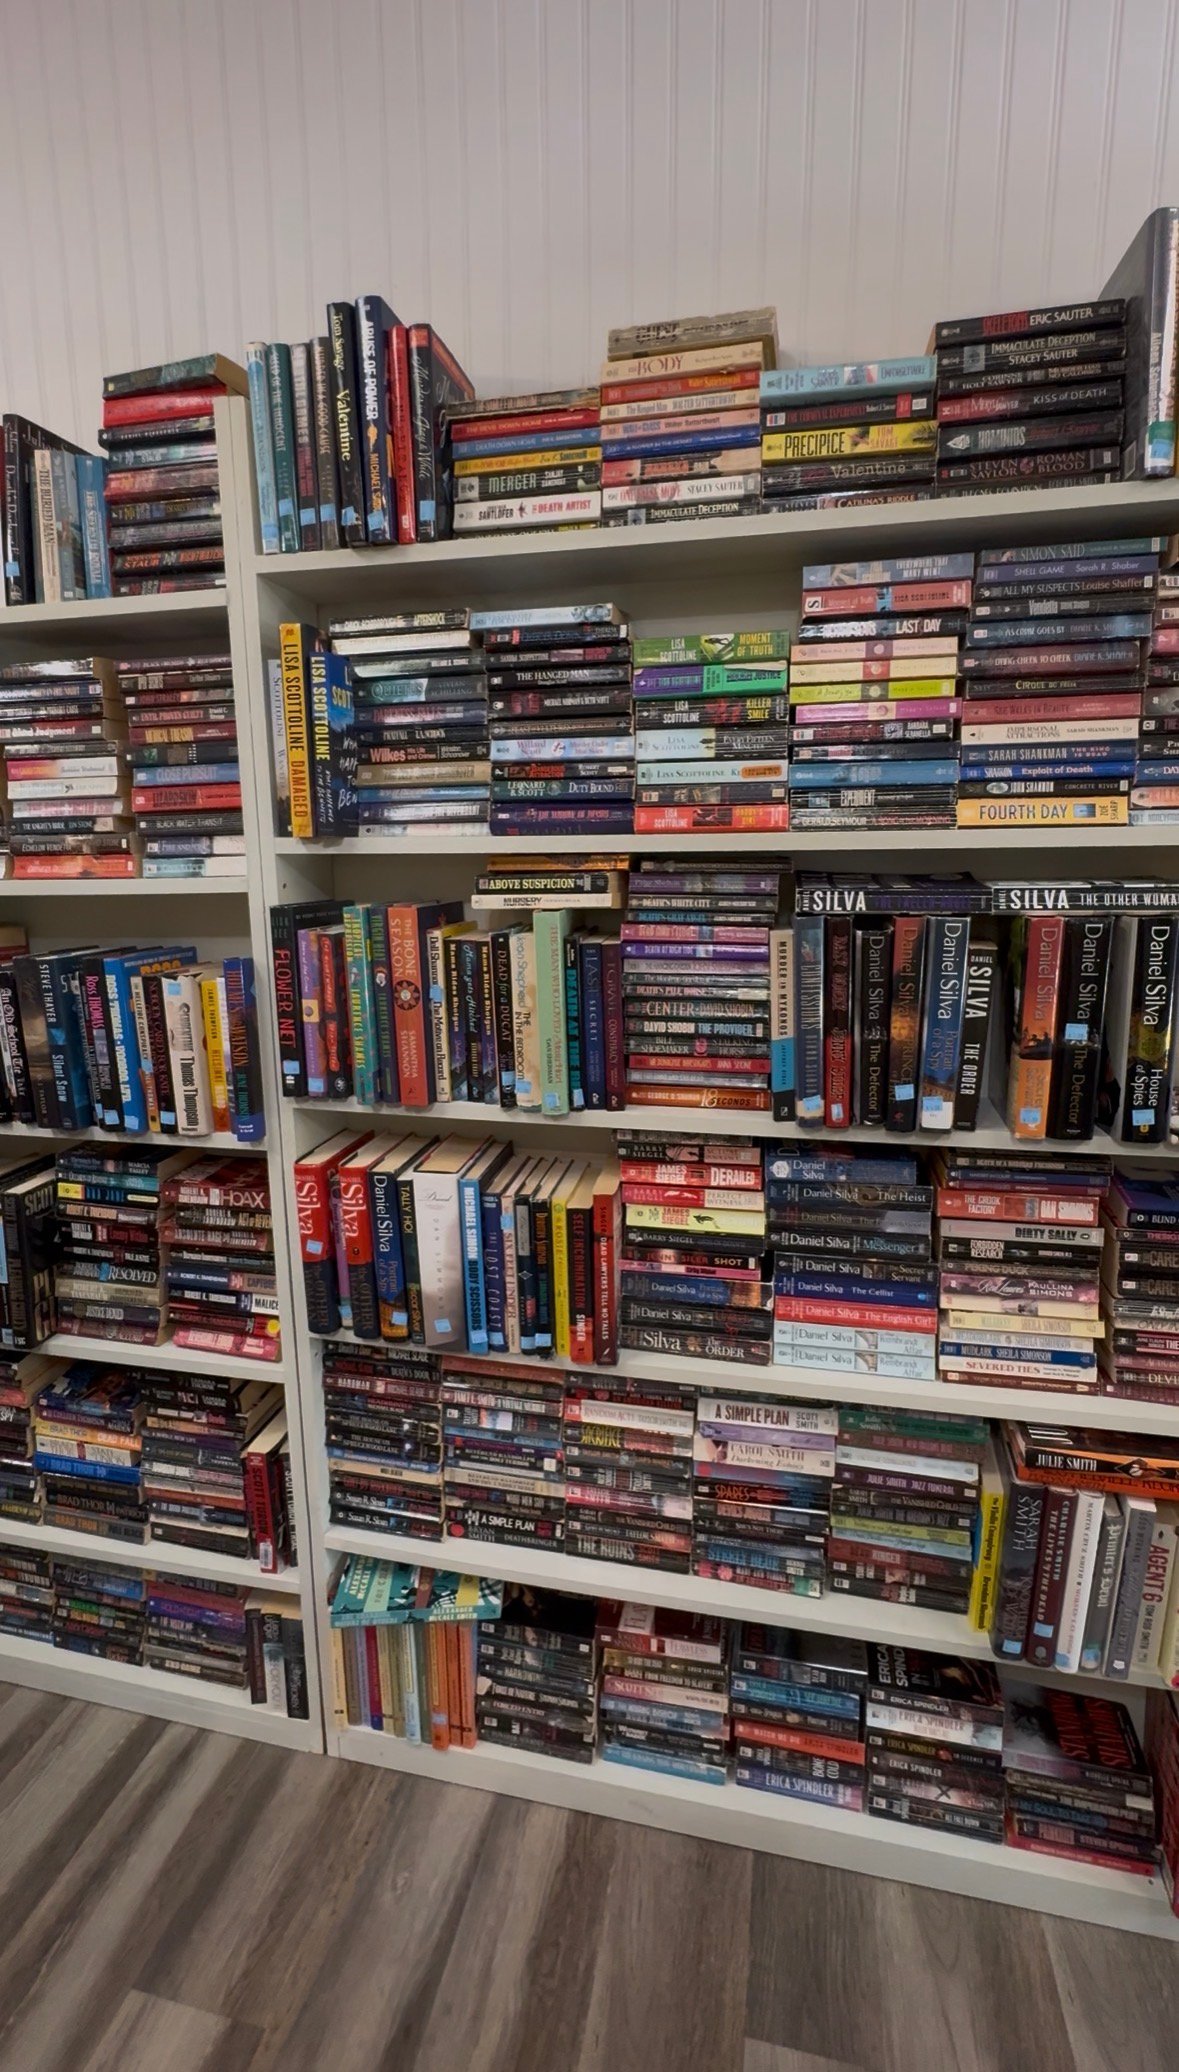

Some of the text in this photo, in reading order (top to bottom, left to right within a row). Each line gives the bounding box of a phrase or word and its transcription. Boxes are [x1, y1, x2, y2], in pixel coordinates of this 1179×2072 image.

[1030, 314, 1053, 326] ERIC
[1054, 307, 1094, 322] SAUTER
[991, 332, 1096, 354] IMMACULATE DECEPTION
[636, 355, 684, 376] BODY
[1009, 348, 1078, 365] STACEY SAUTER
[364, 360, 377, 375] OF
[365, 377, 378, 420] POWER
[336, 388, 352, 462] Valentine
[784, 431, 845, 458] PRECIPICE
[369, 453, 380, 490] MICHAEL
[831, 463, 906, 479] Valentine
[969, 459, 1018, 470] STEVEN
[970, 467, 1018, 480] SAYLOR
[1038, 461, 1086, 473] BLOOD
[488, 473, 537, 494] MERGER
[1020, 543, 1085, 562] SIMON SAID
[1003, 577, 1144, 595] ALL MY SUSPECTS Louise Shaffer
[896, 618, 942, 635] LAST DAY
[739, 632, 771, 645] MOMENT
[310, 656, 331, 761] LISA SCOTTOLINE
[674, 700, 688, 711] LISA
[746, 698, 771, 709] KILLER
[662, 712, 700, 723] SCOTTOLINE
[747, 709, 770, 720] SMILE
[283, 643, 309, 818] LISA SCOTTOLINE DAMAGED
[370, 747, 406, 763] Wilkes
[988, 748, 1067, 761] SARAH SHANKMAN
[508, 781, 545, 789] LEONARD
[979, 803, 1068, 820] FOURTH DAY
[488, 878, 575, 889] ABOVE SUSPICION
[812, 891, 867, 912] SILVA
[1010, 890, 1070, 909] SILVA
[390, 918, 404, 977] SEASON
[403, 917, 417, 977] THE BONE
[971, 955, 993, 963] DANIEL
[868, 935, 885, 1020] Daniel Silva
[937, 922, 962, 1020] Daniel Silva
[1034, 926, 1059, 1021] Daniel Silva
[1077, 922, 1104, 1019] Daniel Silva
[1143, 925, 1171, 1026] Daniel Silva
[39, 963, 57, 1023] STEVE THAYER
[274, 948, 297, 1049] FLOWER NET
[964, 966, 993, 1019] SILVA
[515, 1011, 523, 1020] IN
[646, 1001, 694, 1016] CENTER
[523, 1011, 531, 1026] THE
[6, 1024, 21, 1056] School
[401, 1030, 411, 1078] SHANNON
[516, 1037, 525, 1080] BEDROOM
[12, 1058, 23, 1074] Tie
[960, 1043, 980, 1095] THE ORDER
[52, 1054, 68, 1102] Silent Snow
[180, 1056, 199, 1128] Thomas Thompson
[1148, 1068, 1163, 1107] House
[711, 1097, 751, 1107] SECONDS
[655, 1164, 687, 1175] JAMES
[793, 1161, 826, 1170] Daniel
[655, 1173, 687, 1185] SIEGEL
[710, 1167, 755, 1186] DERAILED
[802, 1170, 825, 1180] Silva
[221, 1192, 265, 1209] HOAX
[803, 1187, 926, 1202] Daniel Silva The Heist
[295, 1181, 320, 1235] Silva
[340, 1184, 367, 1239] Silva
[373, 1175, 393, 1253] Daniel Silva
[463, 1187, 479, 1284] MICHAEL SIMON BODY
[643, 1232, 694, 1244] BARRY SIEGEL
[1015, 1228, 1077, 1241] DIRTY SALLY
[790, 1233, 915, 1255] Daniel Silva Messenger
[714, 1257, 742, 1266] SHOT
[107, 1264, 156, 1283] RESOLVED
[651, 1282, 696, 1295] Daniel Silva
[798, 1282, 821, 1292] Daniel
[824, 1284, 844, 1294] Silva
[869, 1288, 894, 1297] Cellist
[1028, 1281, 1074, 1291] PAULLINA
[1029, 1289, 1073, 1298] SIMONS
[254, 1298, 279, 1311] MALICE
[641, 1306, 692, 1321] Daniel Silva
[642, 1332, 744, 1358] Silva ORDER
[966, 1361, 1040, 1374] SEVERED TIES
[715, 1404, 790, 1426] A SIMPLE PLAN
[796, 1411, 819, 1421] SCOTT
[796, 1420, 819, 1429] SMITH
[1036, 1454, 1097, 1472] JULIE SMITH
[252, 1466, 269, 1535] SCOTT TUROW
[348, 1512, 365, 1521] Susan
[371, 1515, 388, 1527] Sloan
[1012, 1495, 1031, 1551] SMITH
[1025, 1499, 1043, 1550] SARAH
[577, 1536, 635, 1560] THE RUINS
[1142, 1544, 1170, 1603] AGENT 6
[879, 1645, 891, 1684] ERICA
[492, 1701, 545, 1717] FORCED ENTRY
[827, 1761, 840, 1779] COLD
[765, 1773, 834, 1798] ERICA SPINDLER
